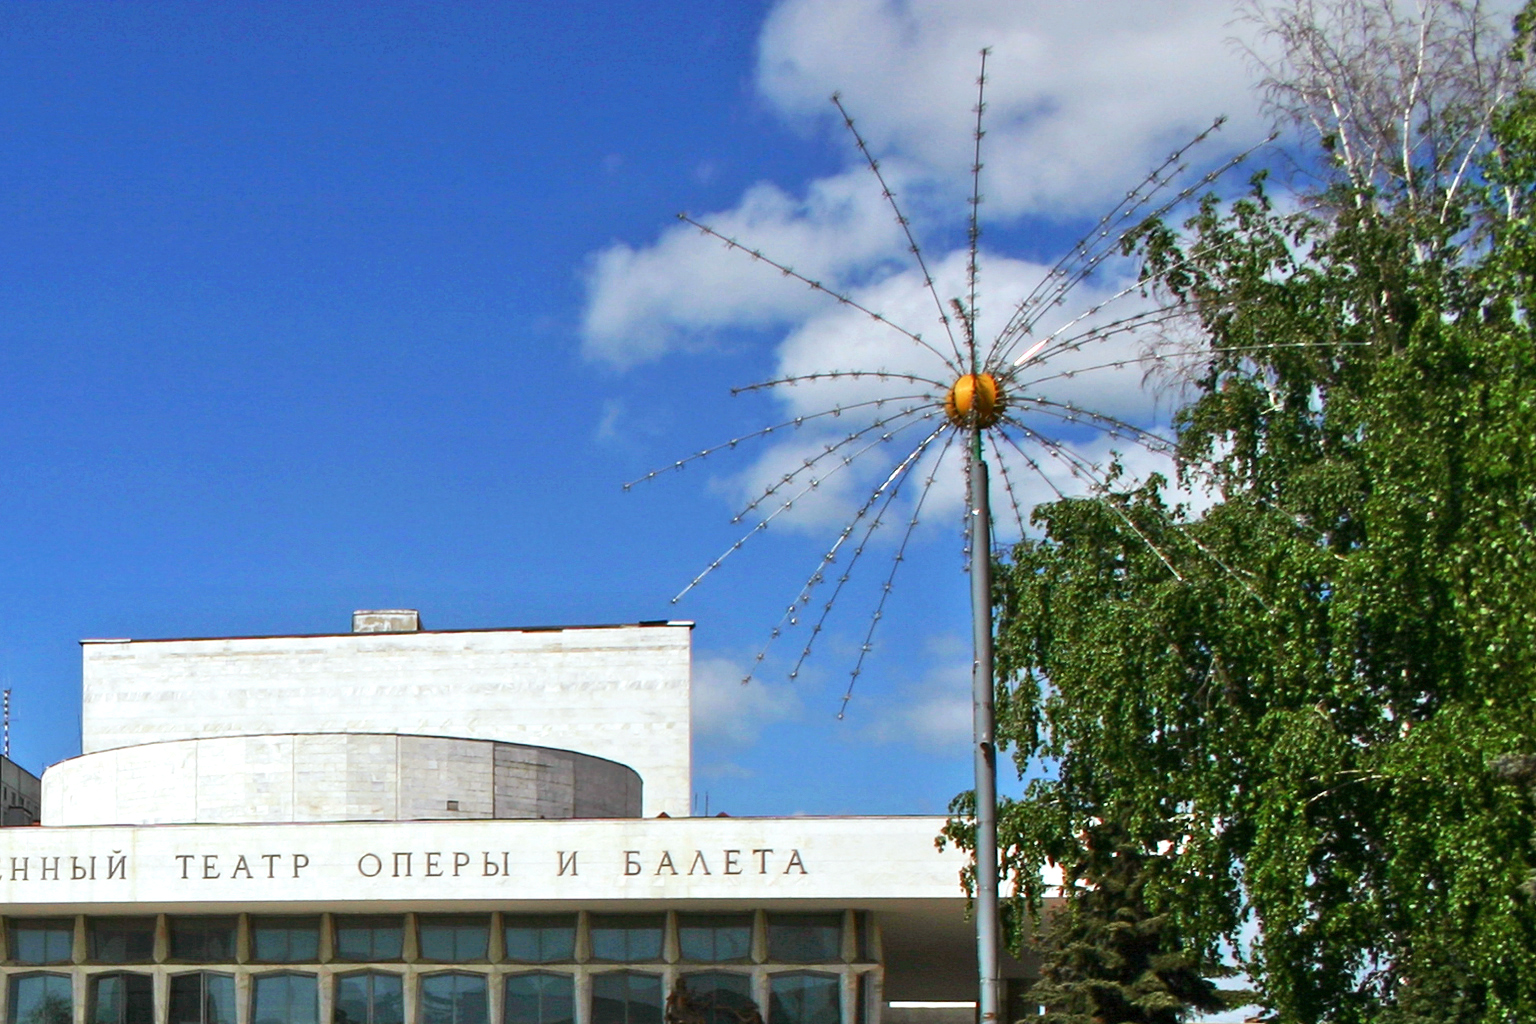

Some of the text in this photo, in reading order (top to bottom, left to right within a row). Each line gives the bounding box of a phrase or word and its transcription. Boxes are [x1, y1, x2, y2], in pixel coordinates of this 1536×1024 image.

[175, 853, 310, 880] ТЕАТР
[357, 851, 511, 878] ОПЕРЫ
[556, 850, 580, 877] И
[622, 848, 809, 876] БАЛЕТА
